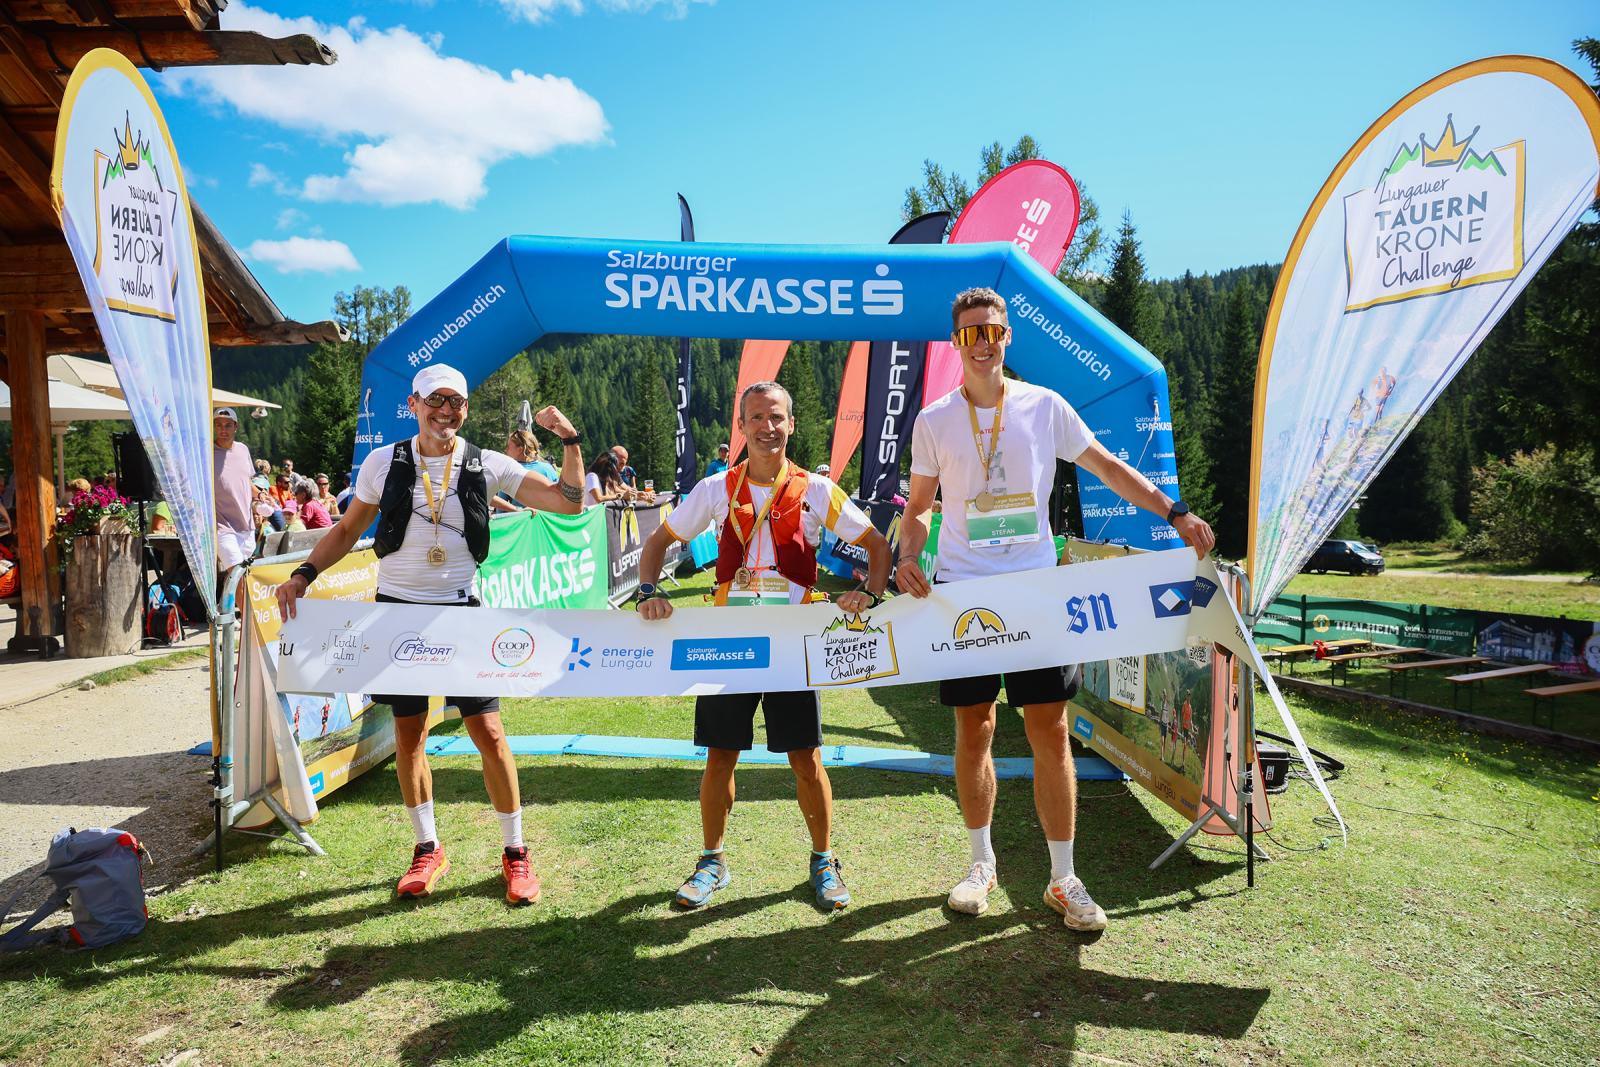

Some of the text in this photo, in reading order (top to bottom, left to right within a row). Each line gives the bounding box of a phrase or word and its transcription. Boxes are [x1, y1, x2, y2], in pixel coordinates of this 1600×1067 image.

[1379, 177, 1451, 210] Lungauer
[1374, 190, 1488, 232] TAUERN
[1376, 217, 1484, 259] KRONE
[605, 249, 737, 275] Salzburger
[1382, 251, 1476, 288] Challenge
[605, 272, 854, 315] SPARKASSE
[407, 281, 506, 368] #glaubandich
[1009, 292, 1112, 382] #glaubandich
[991, 528, 1016, 536] STEFAN
[998, 517, 1007, 528] 2
[1334, 620, 1400, 635] THALHEIM
[498, 642, 529, 650] COOP
[824, 638, 877, 657] TAUERN
[826, 633, 861, 649] Lungauer
[932, 631, 1031, 652] LA SPORTIVA
[602, 646, 654, 659] energie
[686, 652, 744, 662] SPARKASSE
[825, 648, 877, 668] KRONE
[601, 658, 652, 670] Lungau
[831, 663, 877, 680] Challenge
